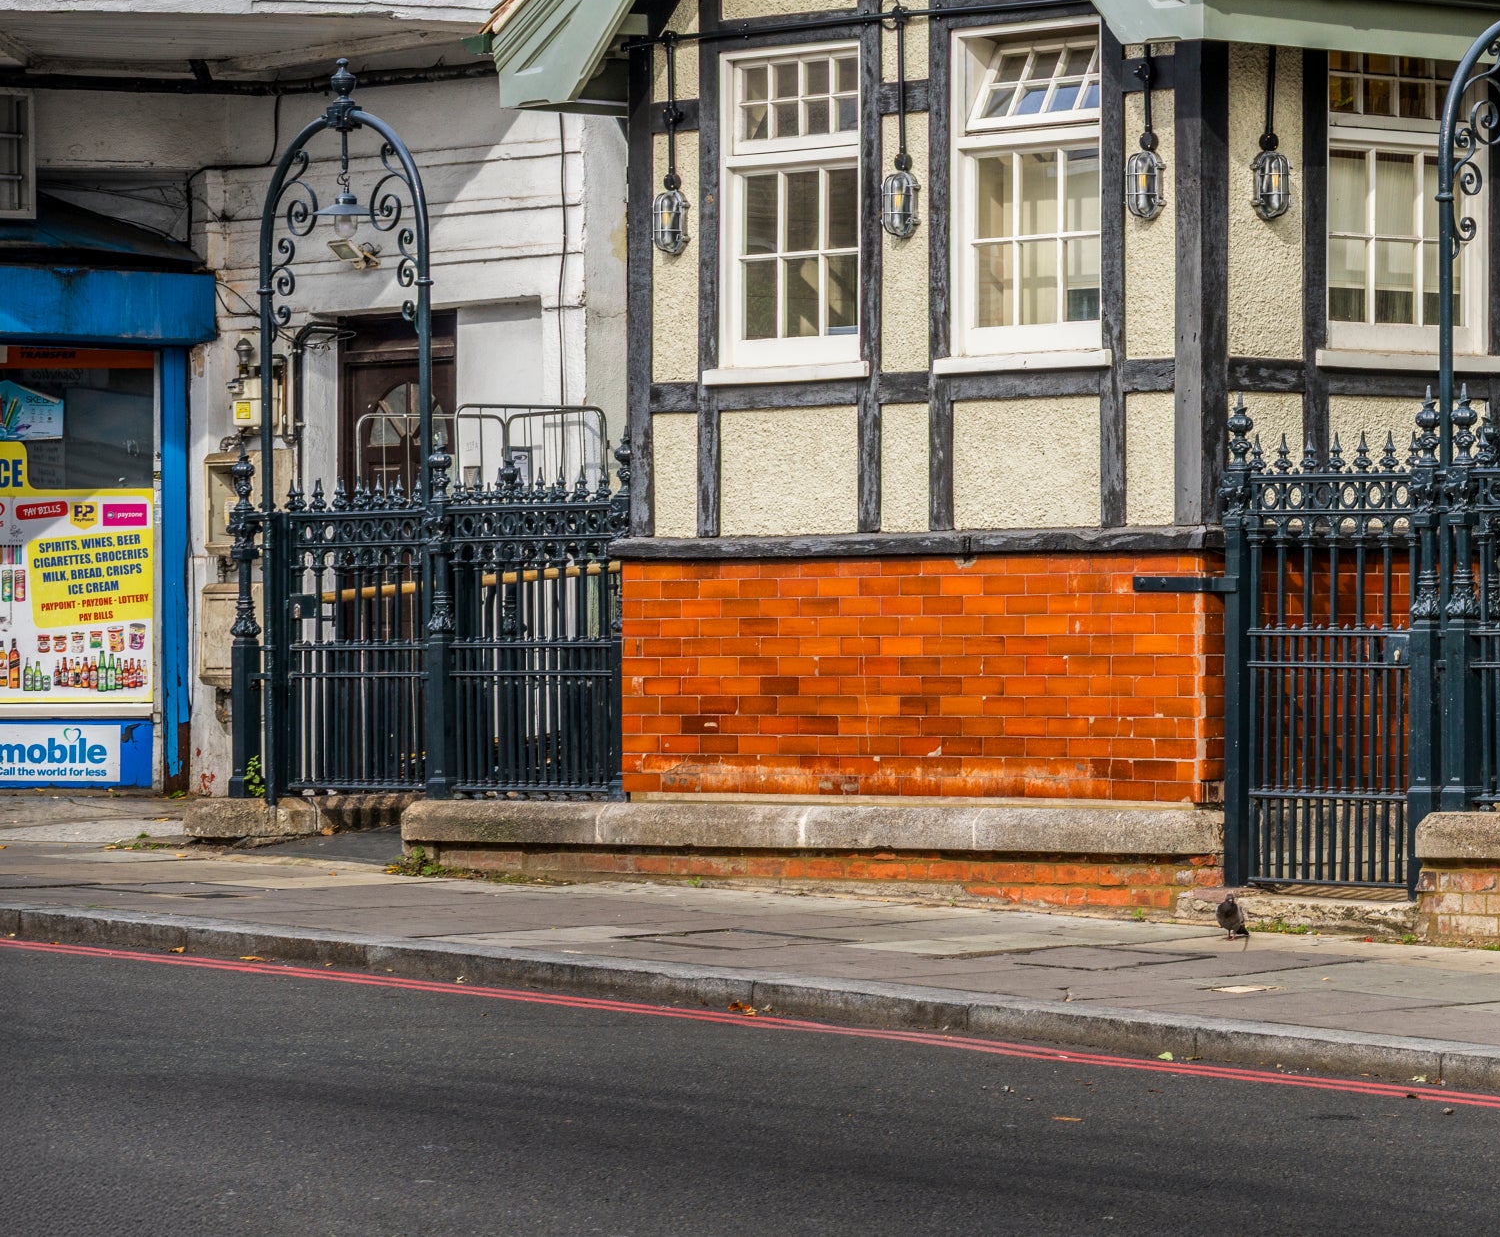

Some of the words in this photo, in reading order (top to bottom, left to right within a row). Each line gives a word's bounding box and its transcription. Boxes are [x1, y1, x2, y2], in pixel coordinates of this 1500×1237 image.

[20, 351, 76, 359] TRANSFER
[0, 459, 23, 488] CE
[23, 508, 37, 516] PAY
[38, 505, 61, 515] BILLS
[39, 540, 80, 553] SPIRITS,
[81, 536, 115, 550] WINES,
[116, 534, 141, 545] BEER
[33, 553, 93, 569] CIGARETTES,
[95, 548, 149, 563] GROCERIES
[42, 571, 69, 583] MILK,
[71, 567, 105, 580] BREAD,
[106, 563, 142, 576] CRISPS
[68, 583, 84, 595] ICE
[86, 580, 119, 593] CREAM
[41, 600, 76, 611] PAYPOINT
[81, 597, 113, 608] PAYZONE
[118, 594, 149, 604] LOTTERY
[79, 613, 93, 622] PAY
[93, 610, 114, 621] BILLS
[0, 737, 107, 764] mobile
[18, 767, 35, 776] the
[37, 767, 67, 776] world
[69, 768, 84, 776] for
[85, 768, 107, 776] less
